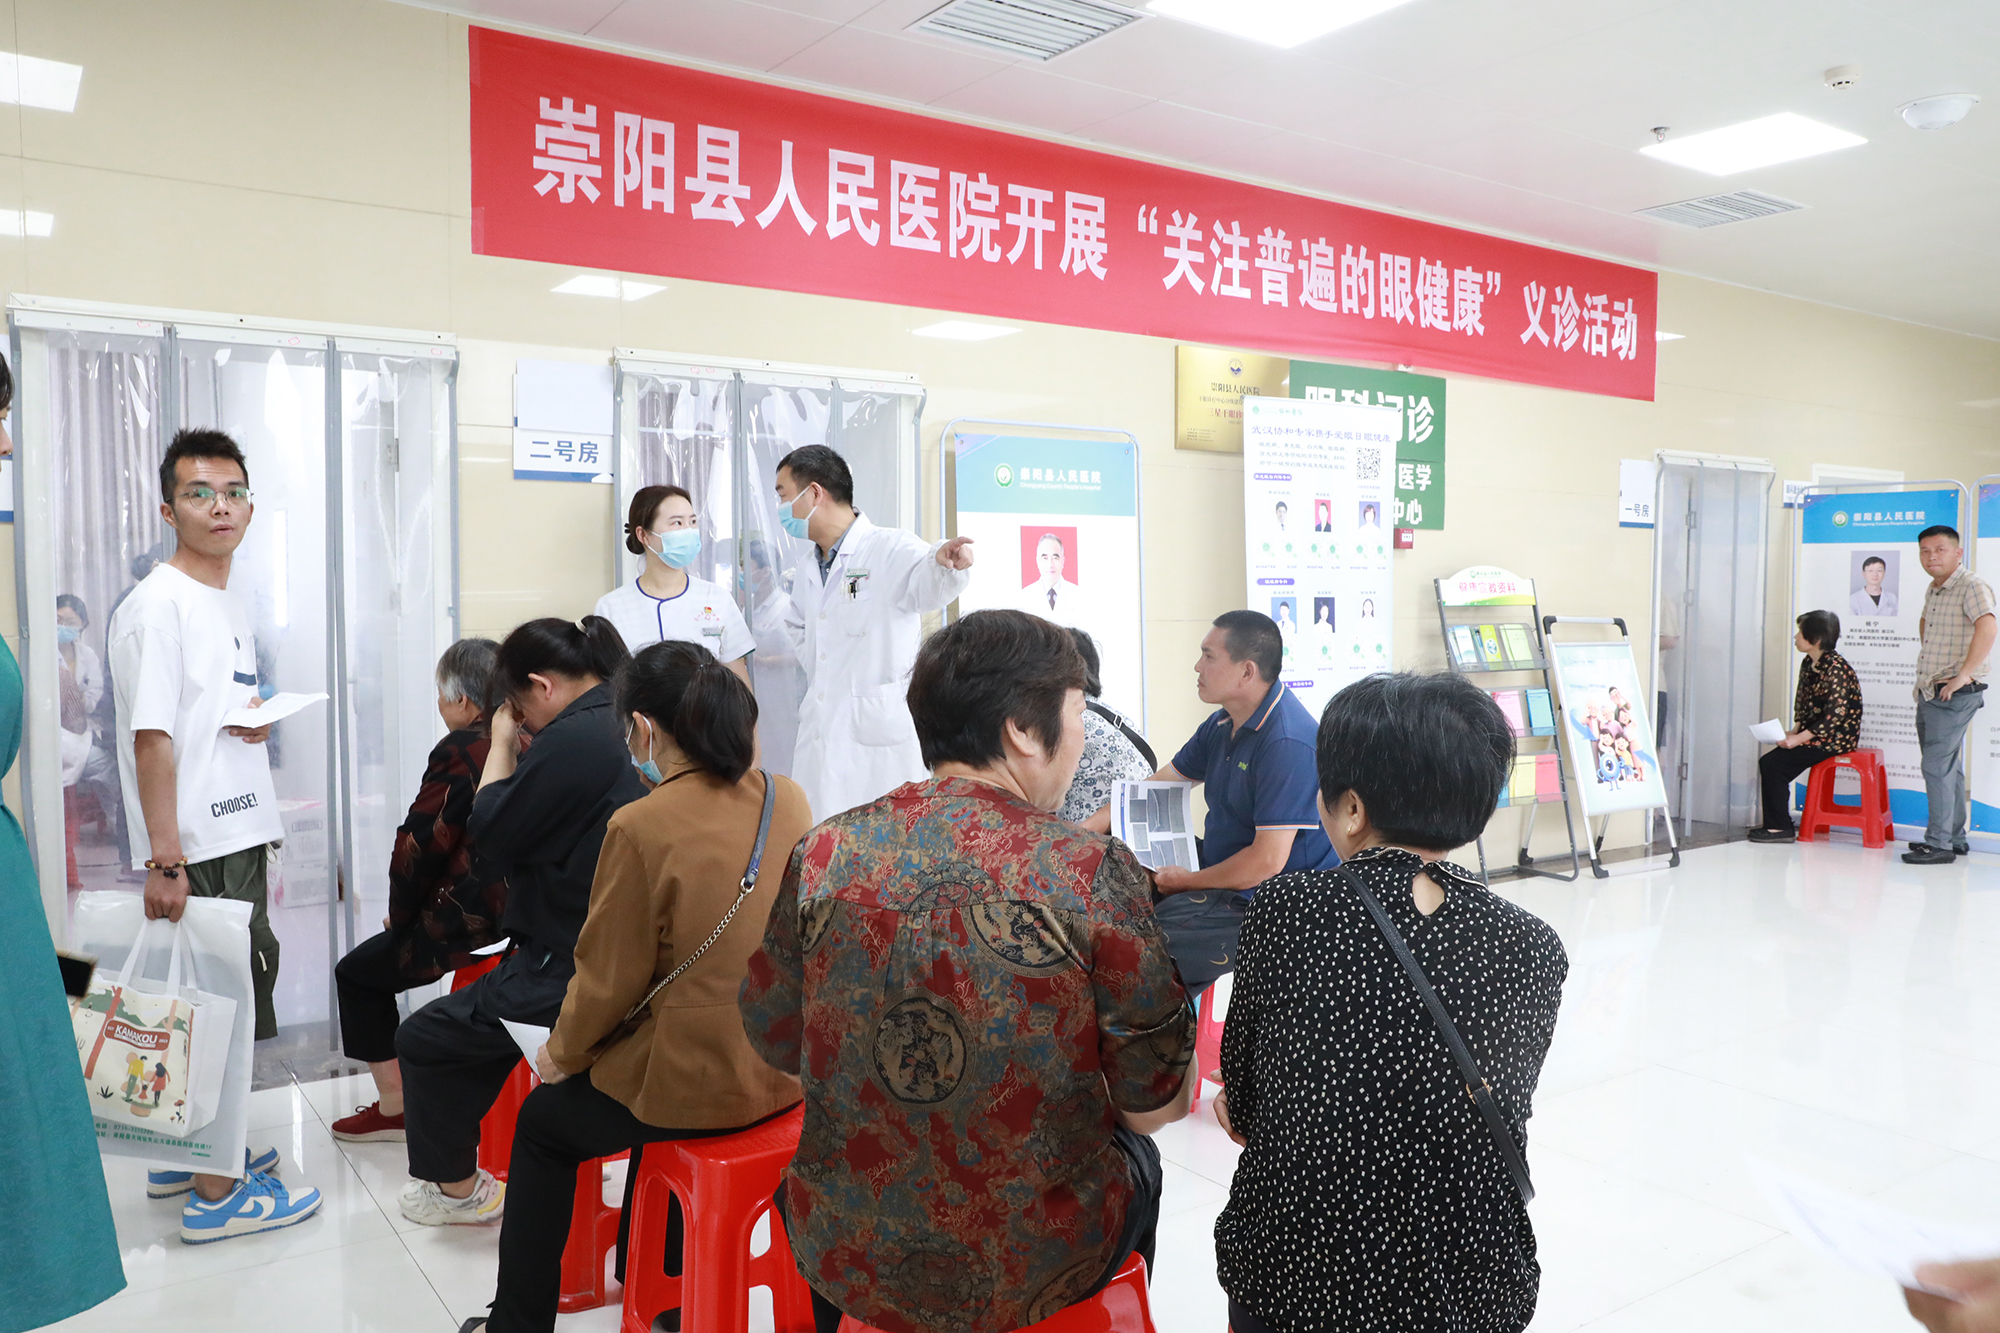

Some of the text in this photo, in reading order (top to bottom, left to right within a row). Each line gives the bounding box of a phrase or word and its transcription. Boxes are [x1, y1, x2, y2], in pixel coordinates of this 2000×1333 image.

[533, 96, 1638, 361] 崇阳县人民医院开展 “关注普遍的眼健康” 义诊活动
[1211, 382, 1260, 396] 崇阳县人民医院
[1251, 425, 1391, 443] 武汉协和专家携手爱眼日眼健康
[529, 440, 599, 464] 二号房
[1020, 467, 1101, 483] 崇阳县人民医院
[1625, 503, 1650, 518] 一号房
[1853, 511, 1926, 522] 崇阳县人民医院
[210, 792, 258, 818] CHOOSE!
